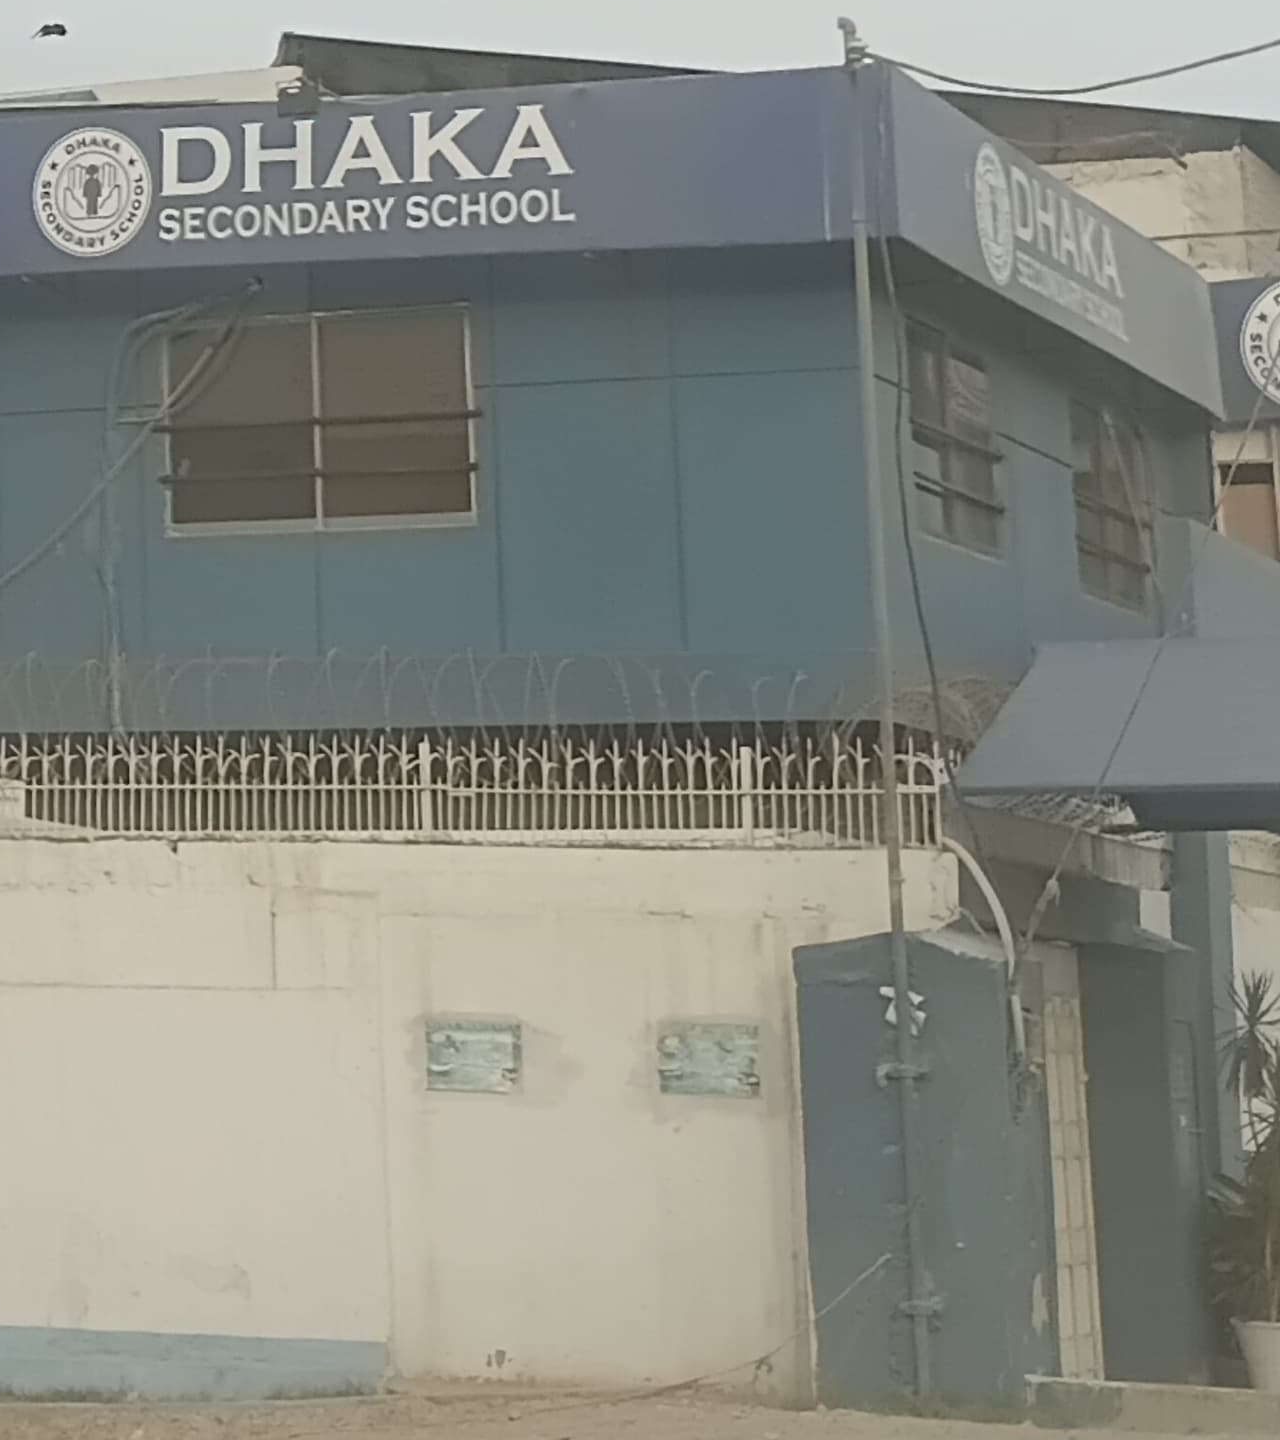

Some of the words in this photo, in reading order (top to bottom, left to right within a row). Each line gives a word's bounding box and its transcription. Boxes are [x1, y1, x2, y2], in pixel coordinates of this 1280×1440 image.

[65, 137, 120, 155] DHAKA
[159, 103, 575, 197] DHAKA
[158, 197, 395, 242] SECONDARY
[405, 189, 576, 229] SCHOOL
[1008, 163, 1124, 298] DHAKA
